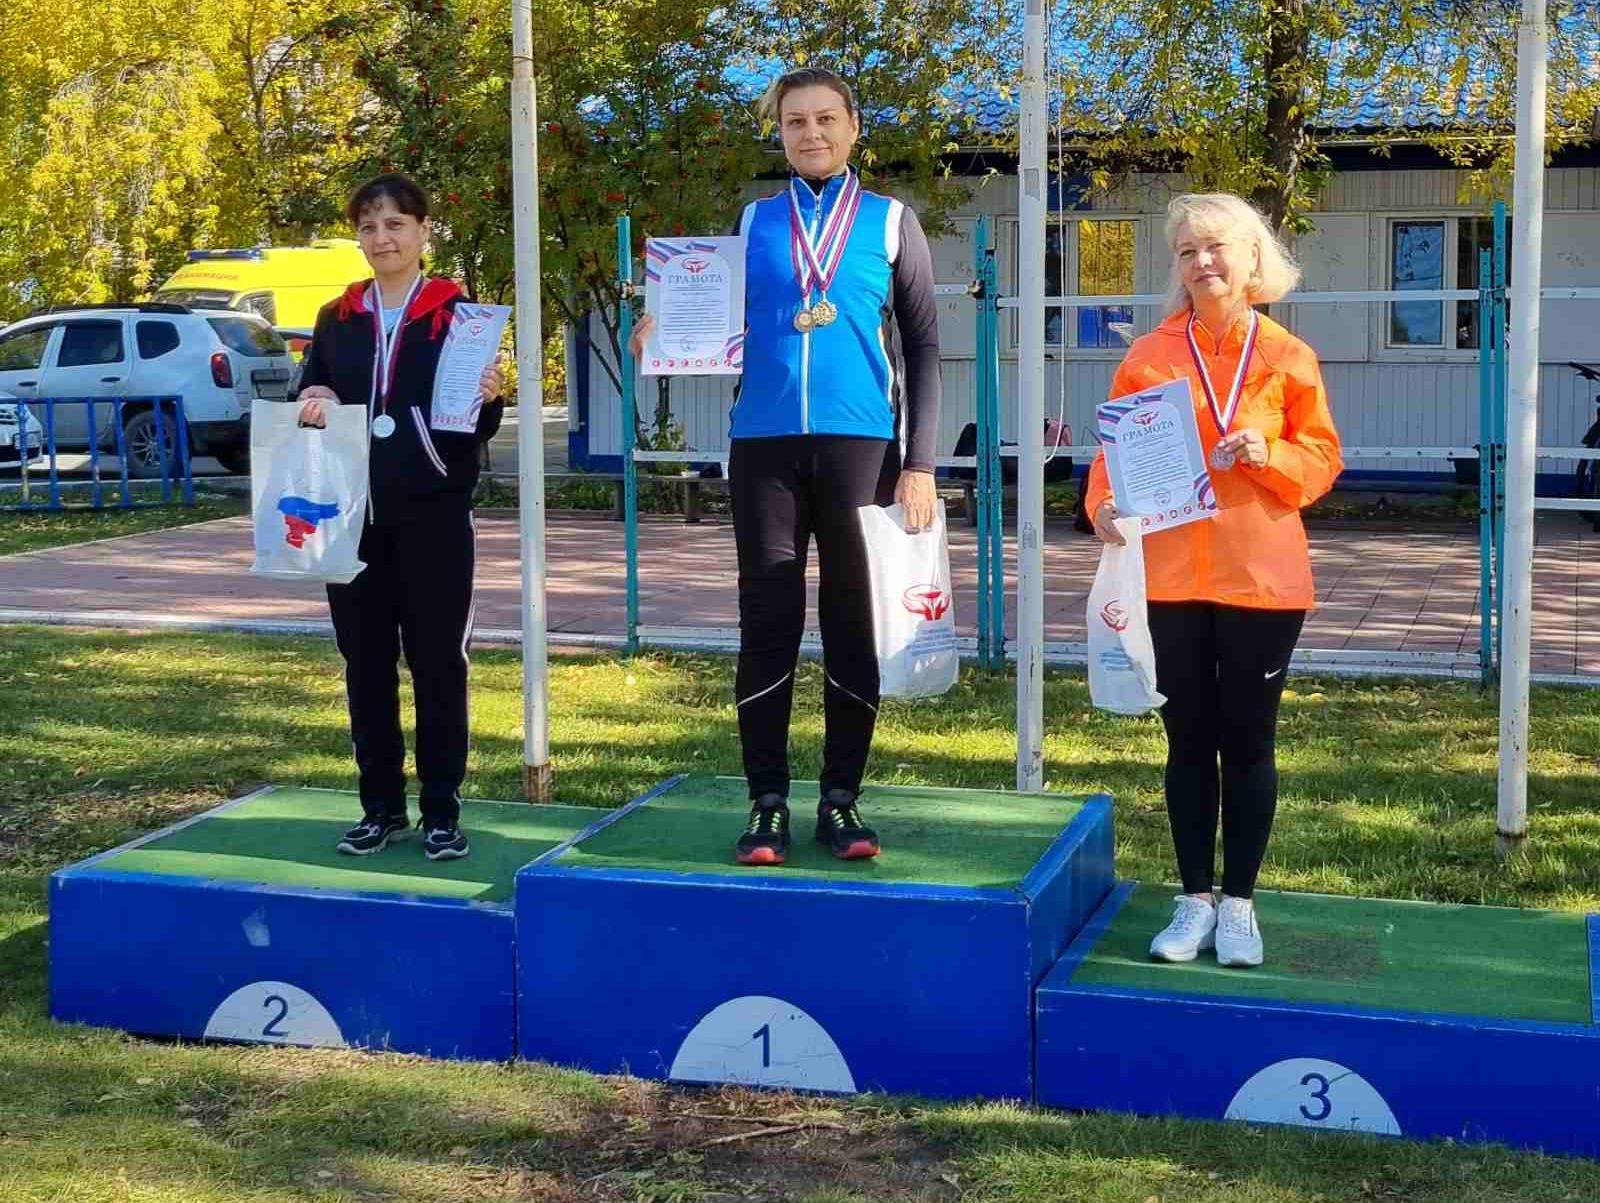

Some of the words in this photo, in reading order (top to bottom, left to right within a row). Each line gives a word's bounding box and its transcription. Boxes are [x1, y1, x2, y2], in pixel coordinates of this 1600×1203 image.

[667, 274, 723, 284] ГРАМОТА
[1121, 420, 1175, 441] ГРАМОТА
[262, 995, 289, 1037] 2
[752, 1024, 770, 1067] 1
[1299, 1072, 1332, 1121] 3
